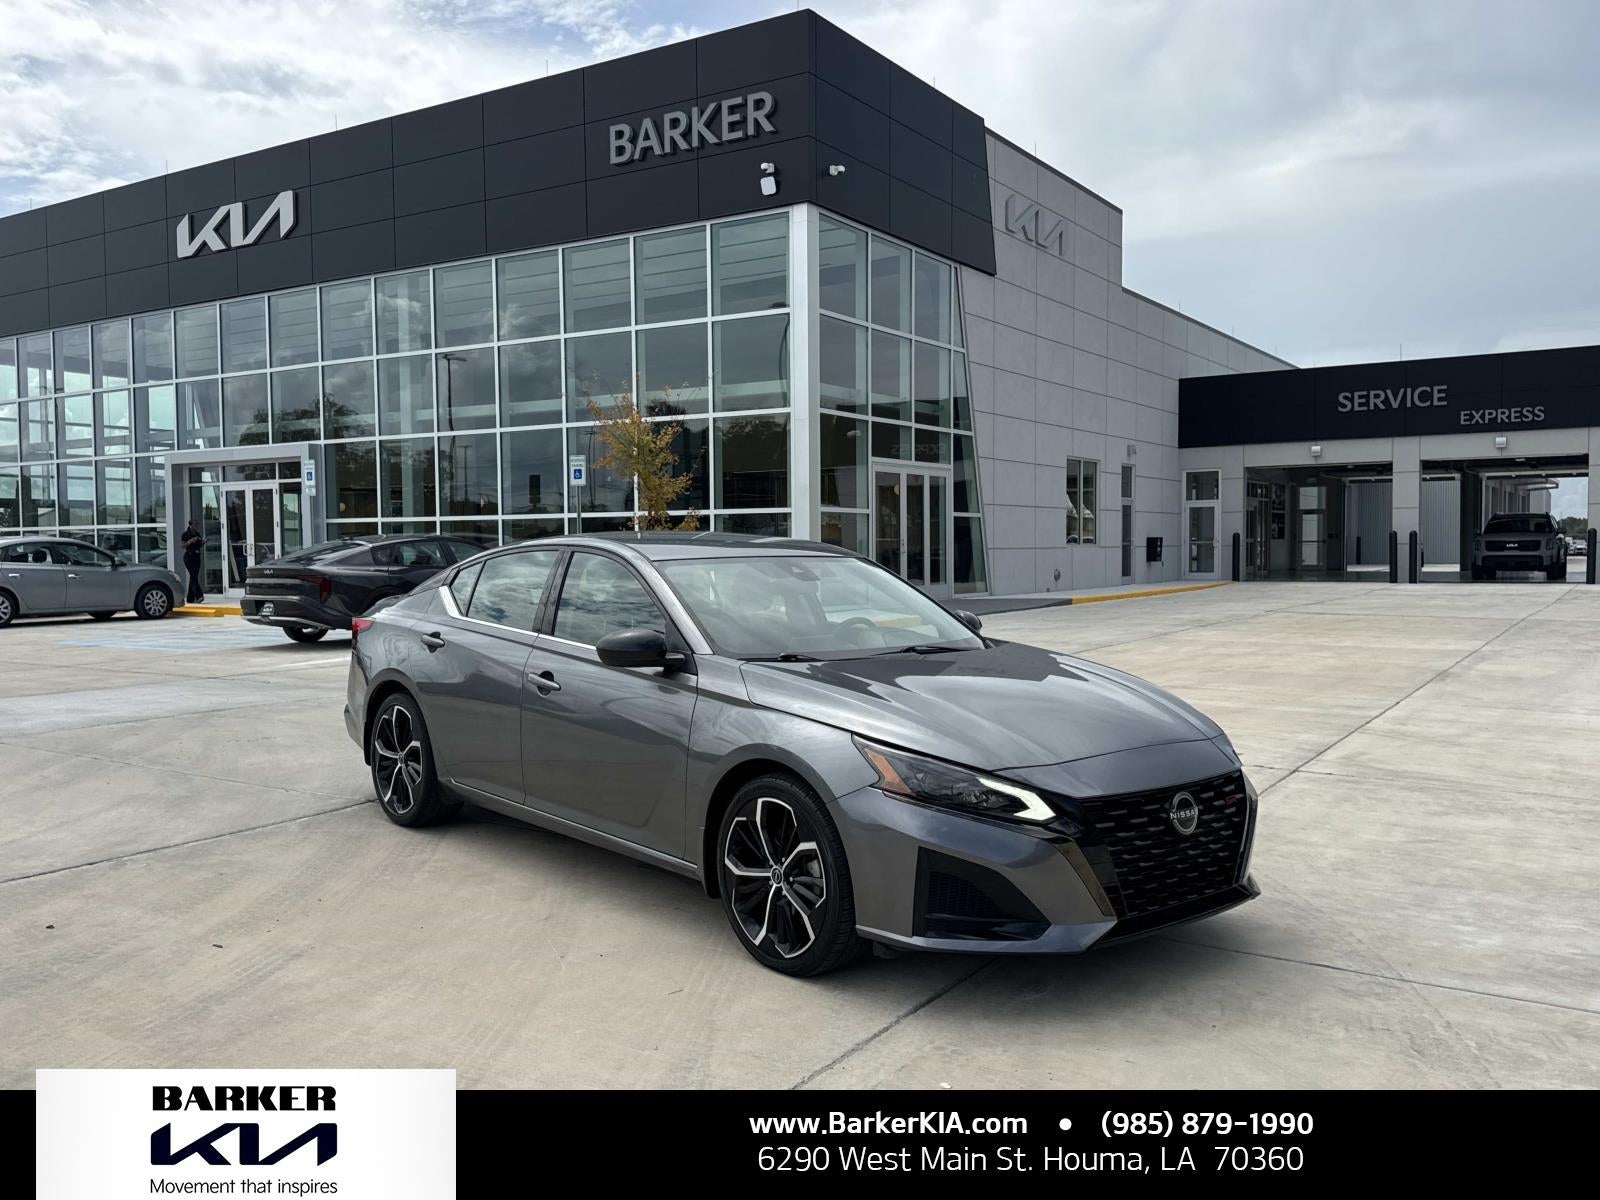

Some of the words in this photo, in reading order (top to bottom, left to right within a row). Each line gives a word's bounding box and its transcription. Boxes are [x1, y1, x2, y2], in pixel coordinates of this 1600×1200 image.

[609, 91, 776, 164] BARKER
[176, 189, 296, 258] KIA
[1337, 385, 1448, 413] SERVICE
[1460, 406, 1545, 425] EXPRESS
